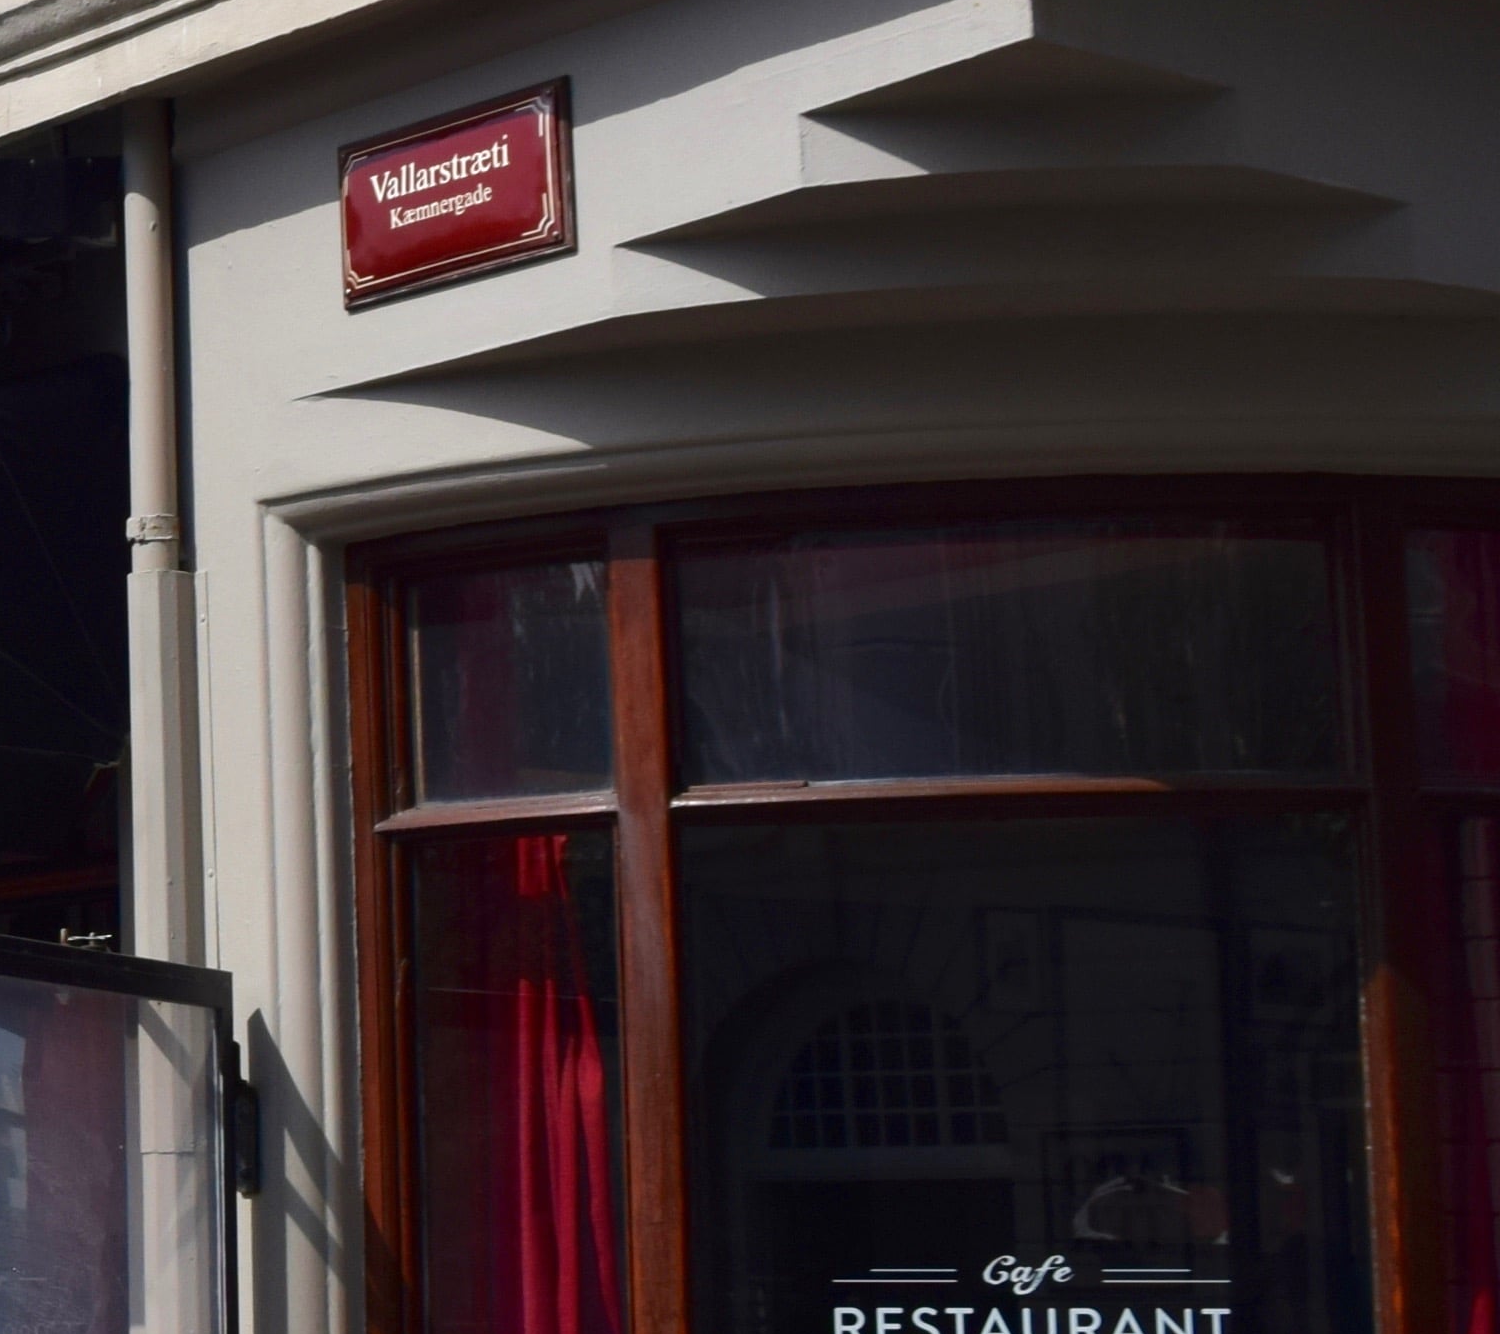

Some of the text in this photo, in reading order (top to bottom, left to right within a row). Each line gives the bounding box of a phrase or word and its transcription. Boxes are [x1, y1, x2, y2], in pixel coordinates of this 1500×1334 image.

[370, 134, 509, 203] Vallarstræti
[390, 183, 492, 229] Kæmnergade
[982, 1254, 1076, 1295] Cafe
